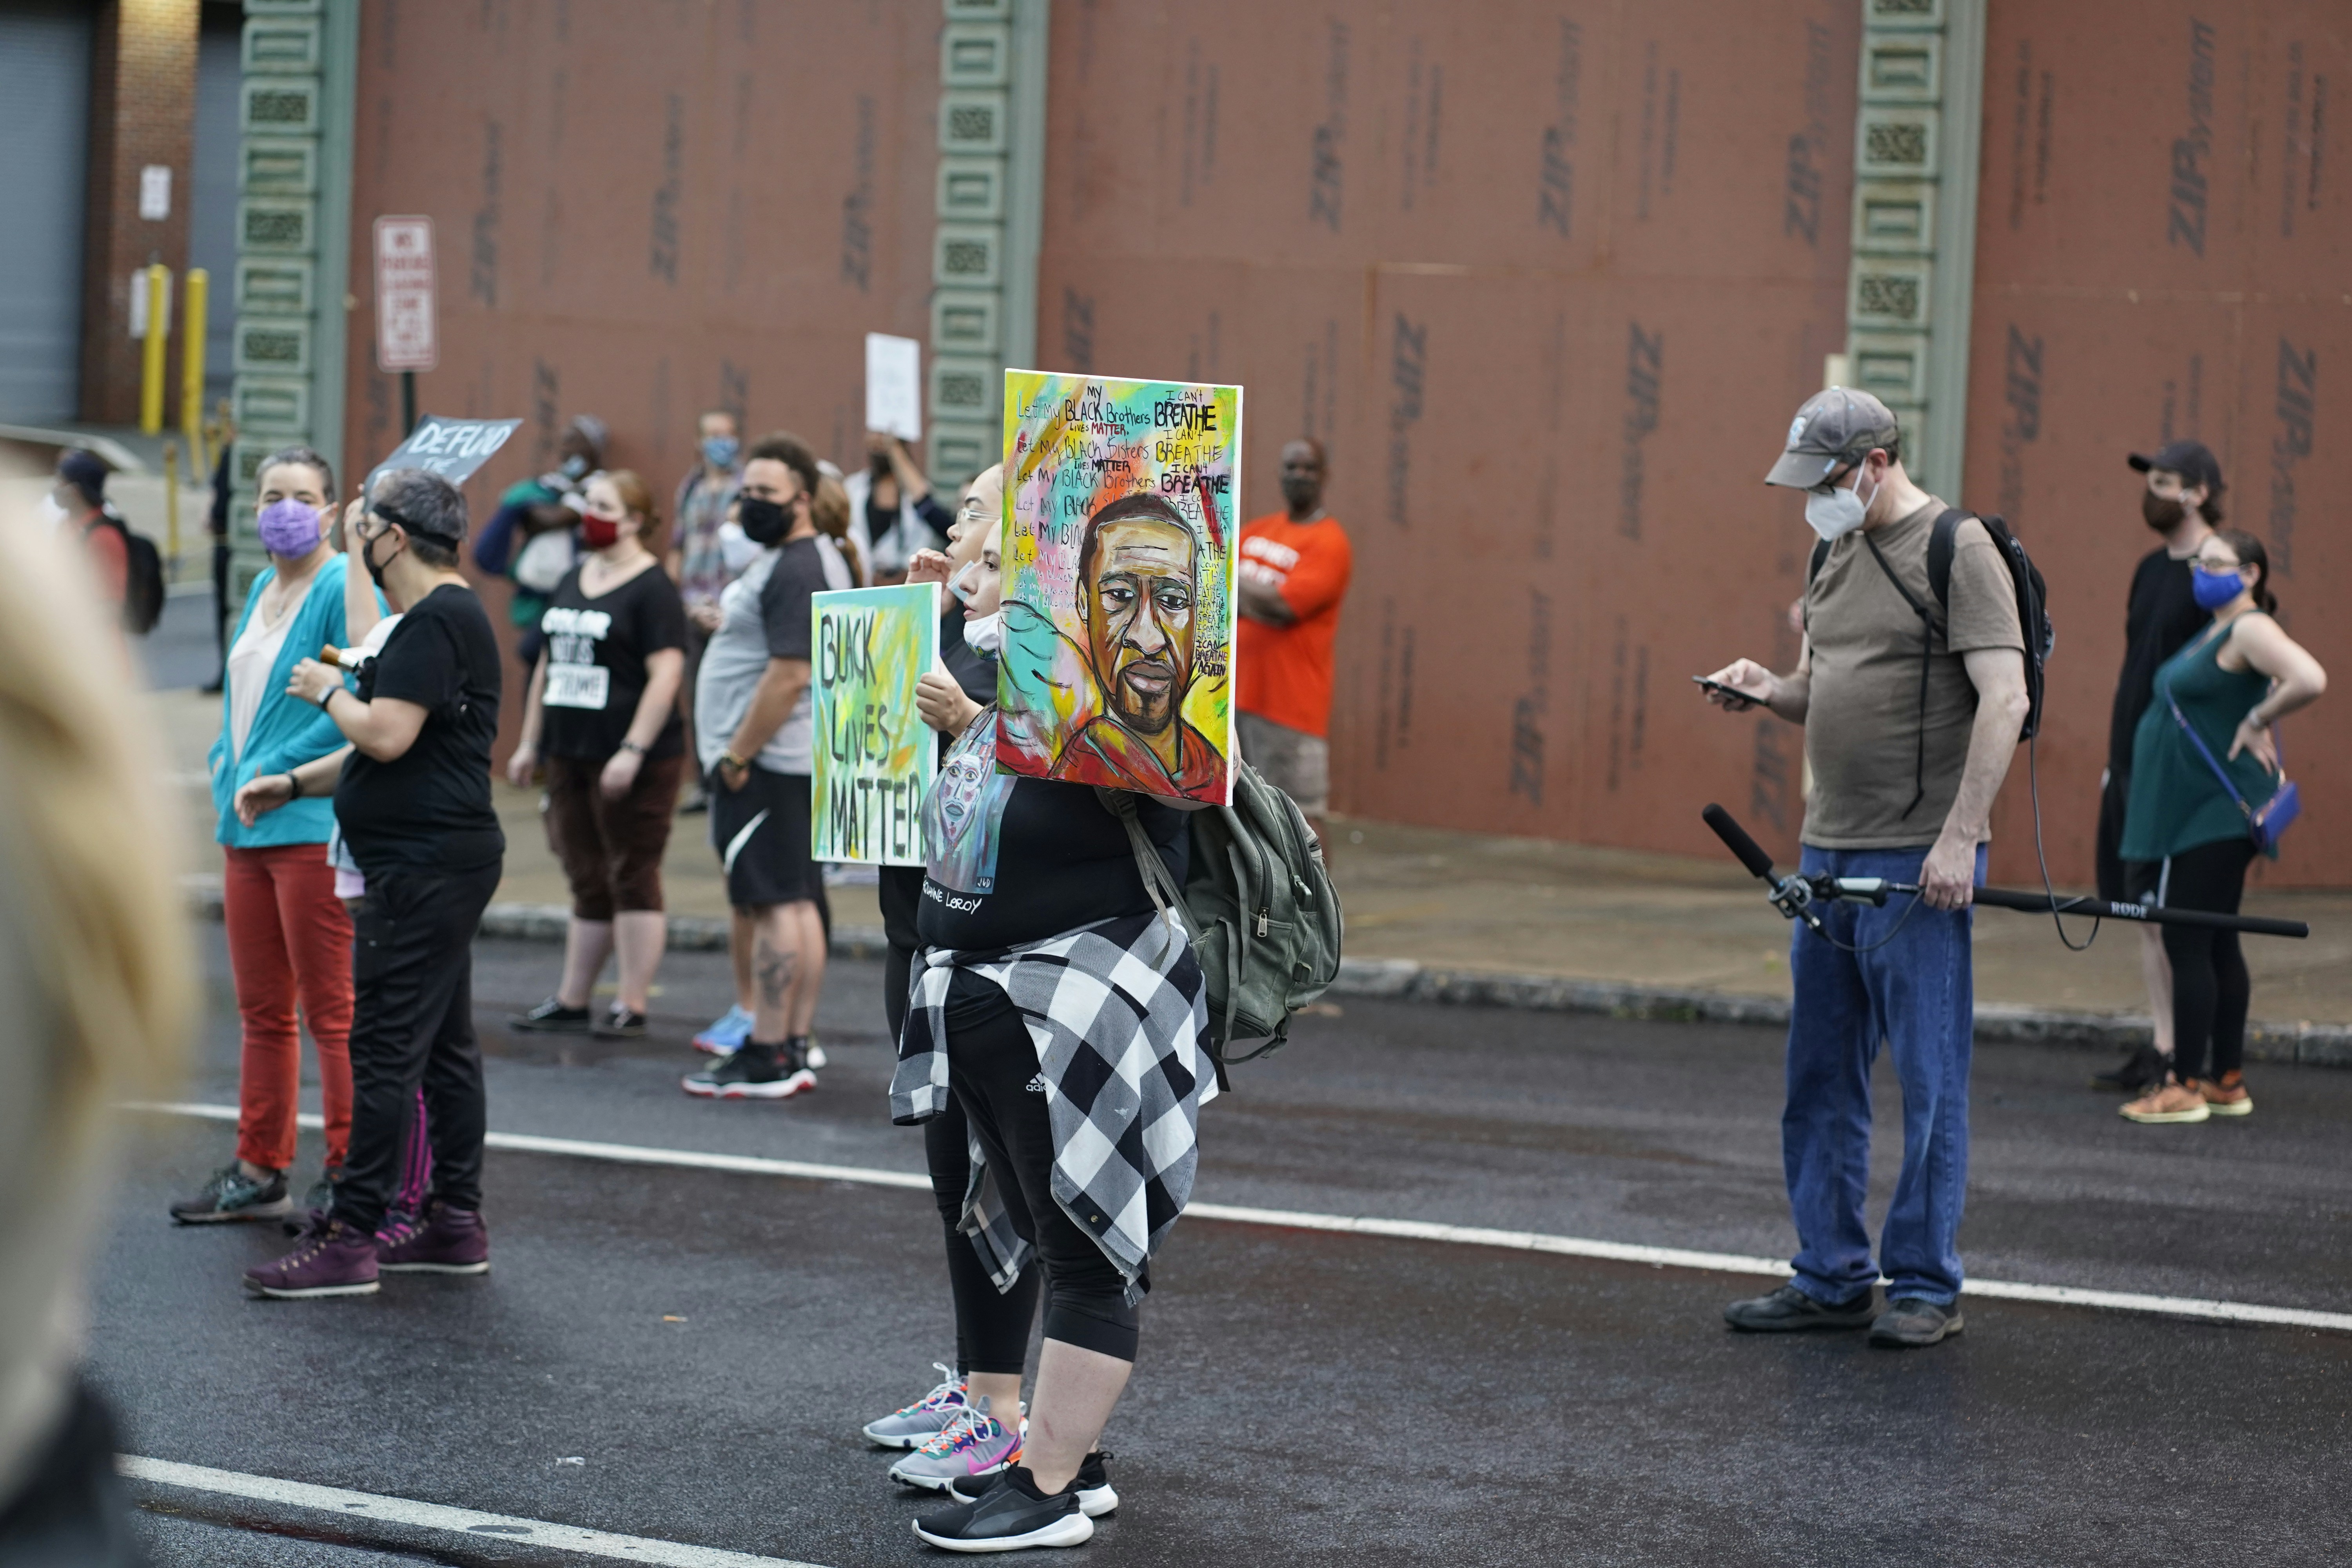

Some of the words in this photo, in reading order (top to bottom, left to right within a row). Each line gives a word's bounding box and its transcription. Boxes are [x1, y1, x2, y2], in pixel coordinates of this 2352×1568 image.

[1166, 390, 1175, 400] I
[1018, 394, 1038, 418] Let
[1065, 399, 1104, 422] BLACK
[1107, 402, 1151, 426] Brothers
[1155, 401, 1217, 432] BREATHE
[1163, 430, 1174, 439] I
[1156, 440, 1223, 463] BREATHE
[1092, 459, 1131, 473] MATTER
[1017, 465, 1033, 481] Let
[1062, 469, 1099, 489] BLACK
[1103, 470, 1156, 490] Brothers
[1161, 473, 1231, 495] BREATHE
[1016, 491, 1034, 512] Let
[1014, 521, 1035, 537] Let
[1013, 544, 1034, 562] Let
[821, 609, 877, 690] BLACK
[831, 699, 890, 768] LIVES
[831, 771, 926, 864] MATTER
